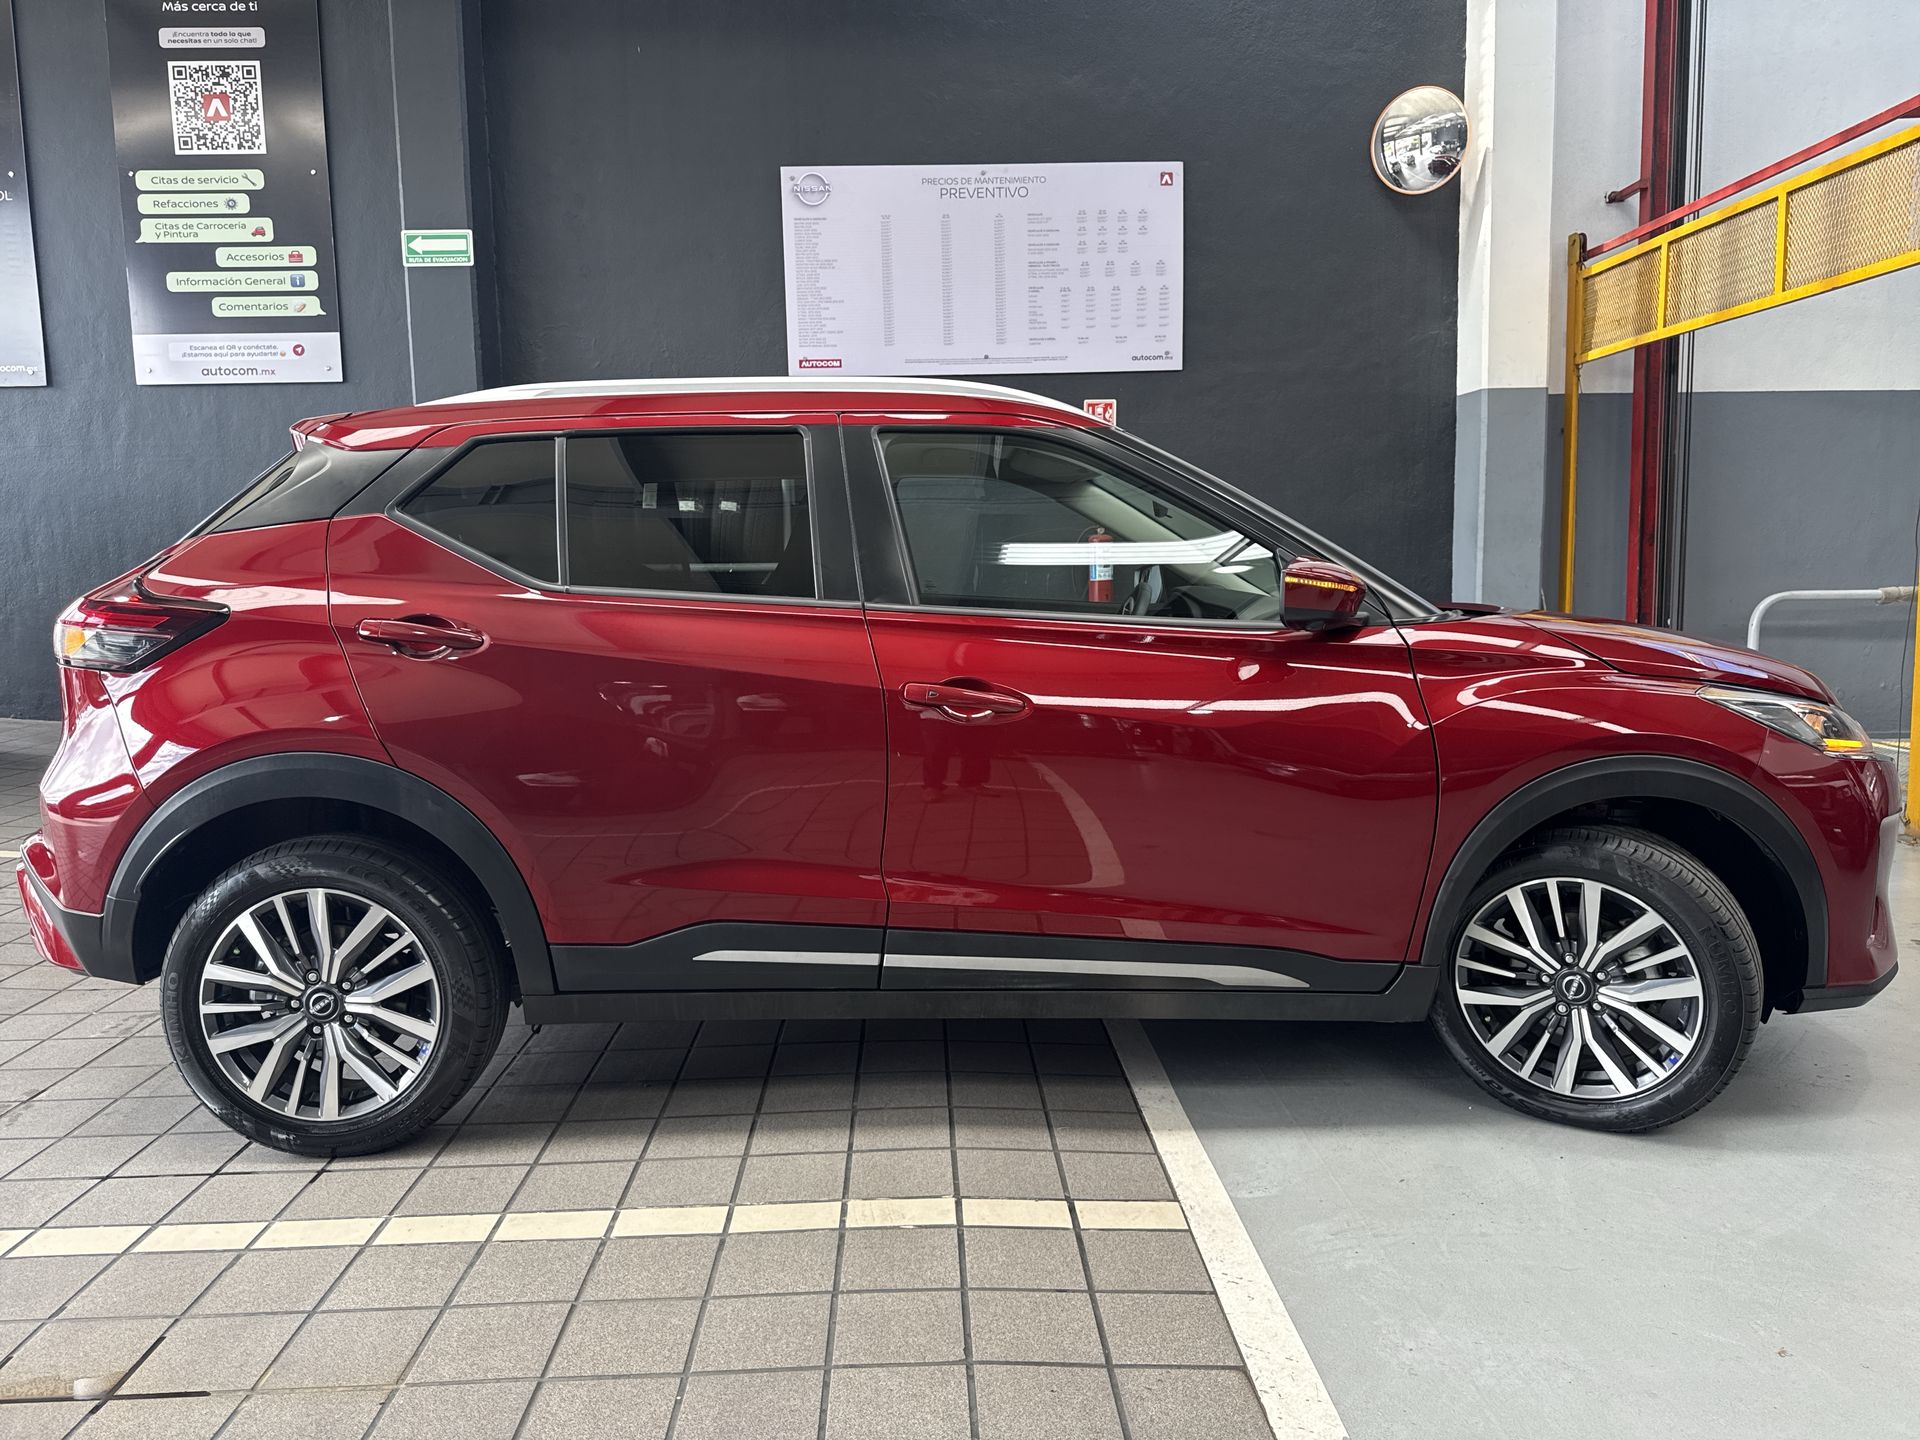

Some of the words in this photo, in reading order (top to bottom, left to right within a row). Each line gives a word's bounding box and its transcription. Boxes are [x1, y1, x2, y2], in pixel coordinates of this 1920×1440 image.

[162, 1, 189, 11] Más
[191, 3, 226, 11] cerca
[229, 1, 246, 11] de
[249, 1, 258, 11] ti
[151, 176, 179, 184] Citas
[181, 175, 195, 184] de
[197, 175, 239, 184] servicio
[921, 177, 959, 185] PRECIOS
[960, 177, 973, 185] DE
[974, 176, 1047, 184] MANTENIMIENTO
[792, 184, 832, 193] NISSAN
[939, 186, 1029, 199] PREVENTIVO
[153, 200, 219, 208] Refacciones
[154, 222, 181, 230] Citas
[183, 222, 194, 230] de
[196, 221, 247, 230] Carrocería
[163, 230, 199, 238] Pintura
[226, 252, 285, 262] Accesorios
[176, 276, 242, 286] Información
[244, 276, 286, 286] General
[218, 302, 289, 312] Comentarios
[801, 360, 841, 368] AUTOCOM
[201, 366, 276, 376] autocom.mx
